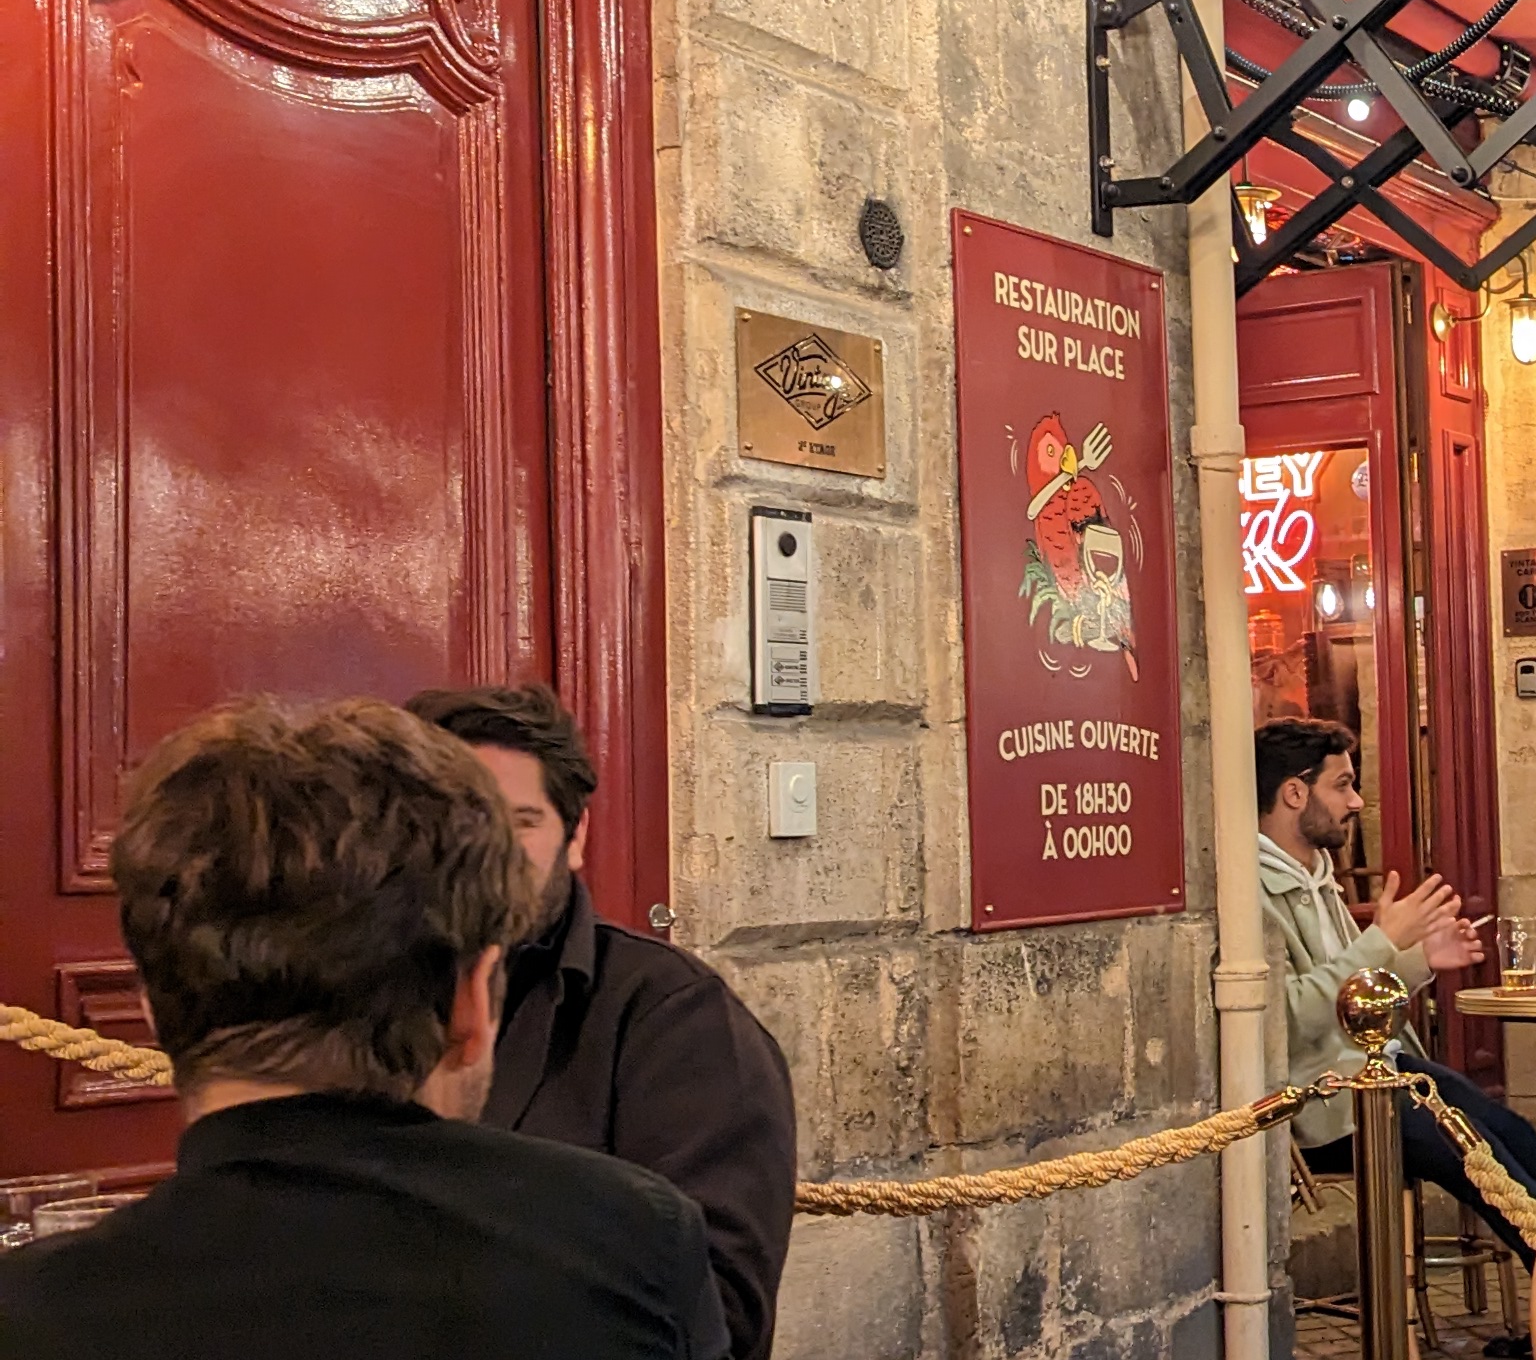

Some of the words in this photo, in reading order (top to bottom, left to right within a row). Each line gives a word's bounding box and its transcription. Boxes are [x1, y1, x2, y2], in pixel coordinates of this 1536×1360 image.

[994, 271, 1140, 339] RESTAURATION
[1018, 325, 1058, 365] SUR
[1063, 336, 1125, 380] PLACE
[999, 720, 1075, 761] CUISINE
[1080, 720, 1159, 760] OUVERTE
[1041, 783, 1068, 815] DE
[1075, 782, 1131, 814] 18H30
[1042, 820, 1058, 860] À
[1063, 824, 1132, 859] 00H00
